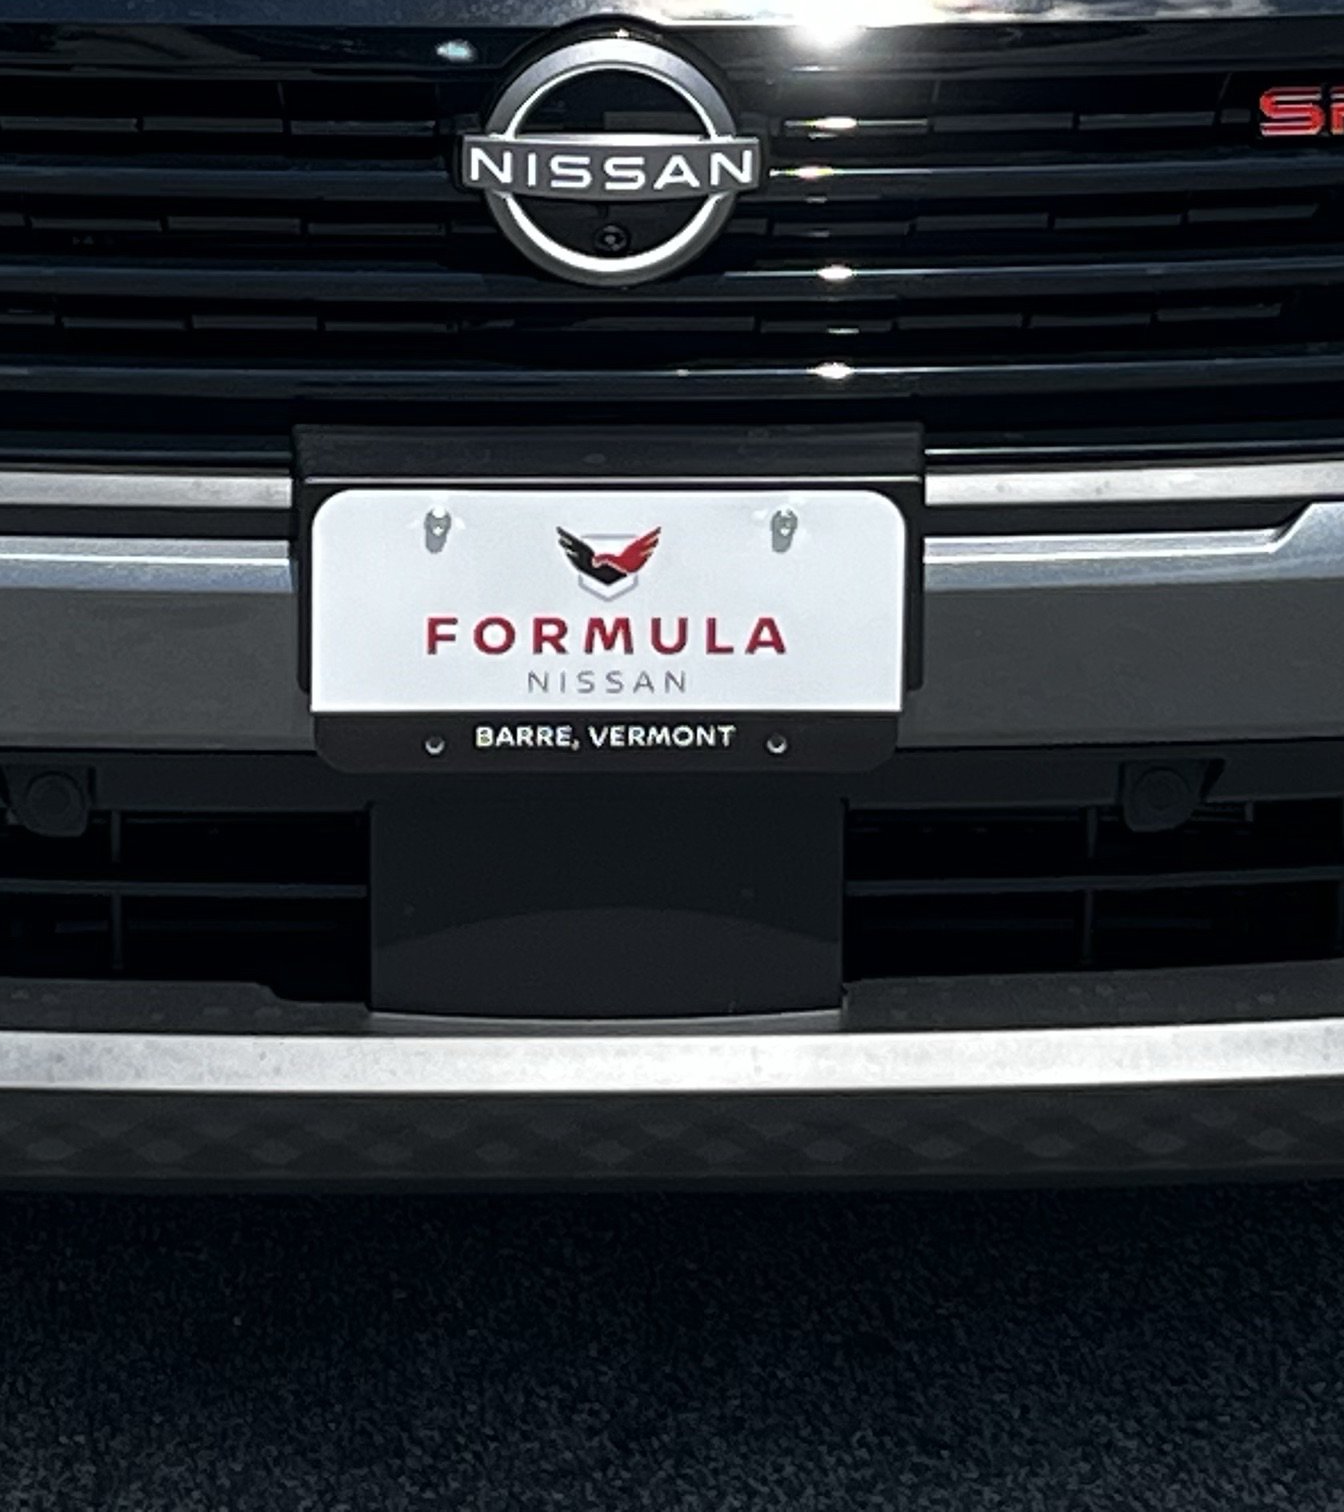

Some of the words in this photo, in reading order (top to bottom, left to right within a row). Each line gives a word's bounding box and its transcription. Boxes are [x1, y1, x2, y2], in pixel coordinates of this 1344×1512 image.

[470, 147, 754, 190] NISSAN
[425, 616, 788, 656] FORMULA
[527, 669, 687, 694] NISSAN
[474, 725, 581, 751] BARRE,
[588, 724, 736, 748] VERMONT
